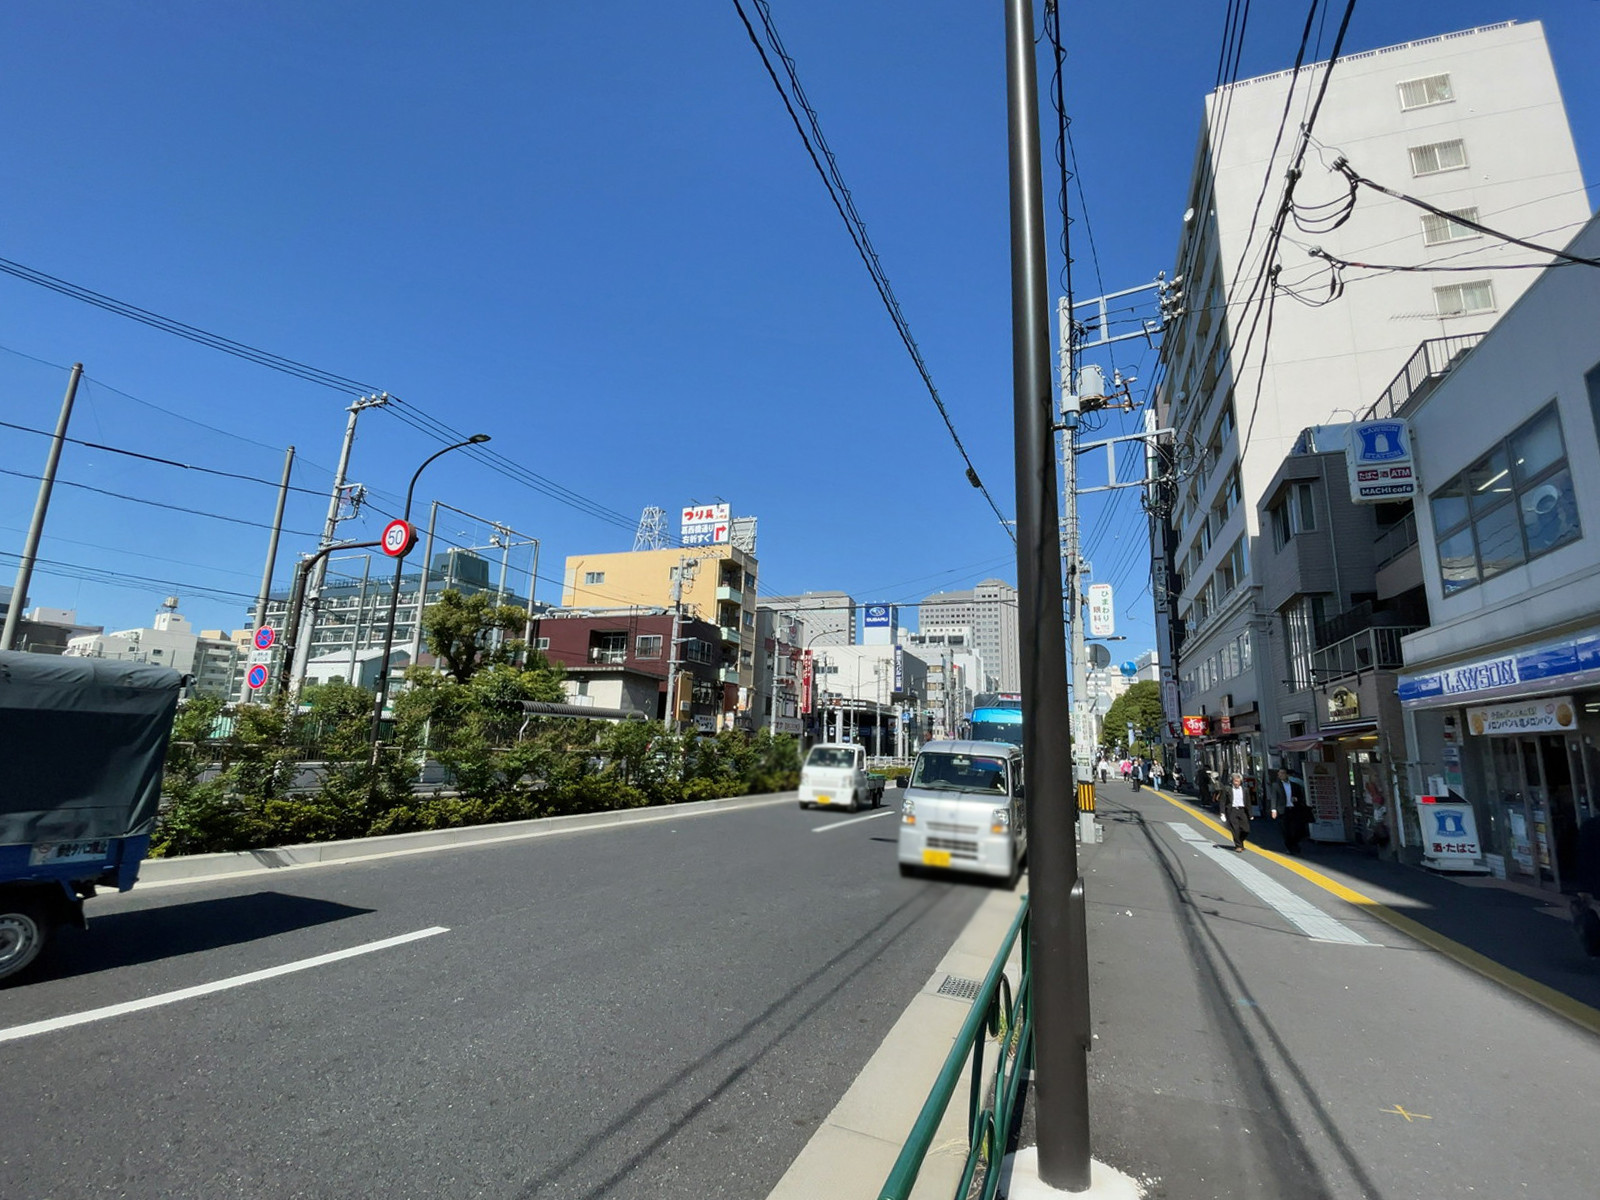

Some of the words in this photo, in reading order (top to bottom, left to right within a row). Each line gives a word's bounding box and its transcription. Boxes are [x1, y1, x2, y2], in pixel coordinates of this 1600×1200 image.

[1391, 469, 1410, 477] ATM
[1362, 487, 1391, 495] MACHI
[684, 509, 713, 520] つり具
[388, 529, 403, 546] 50
[1101, 591, 1110, 622] ひまわり
[1444, 658, 1517, 694] LAWSON
